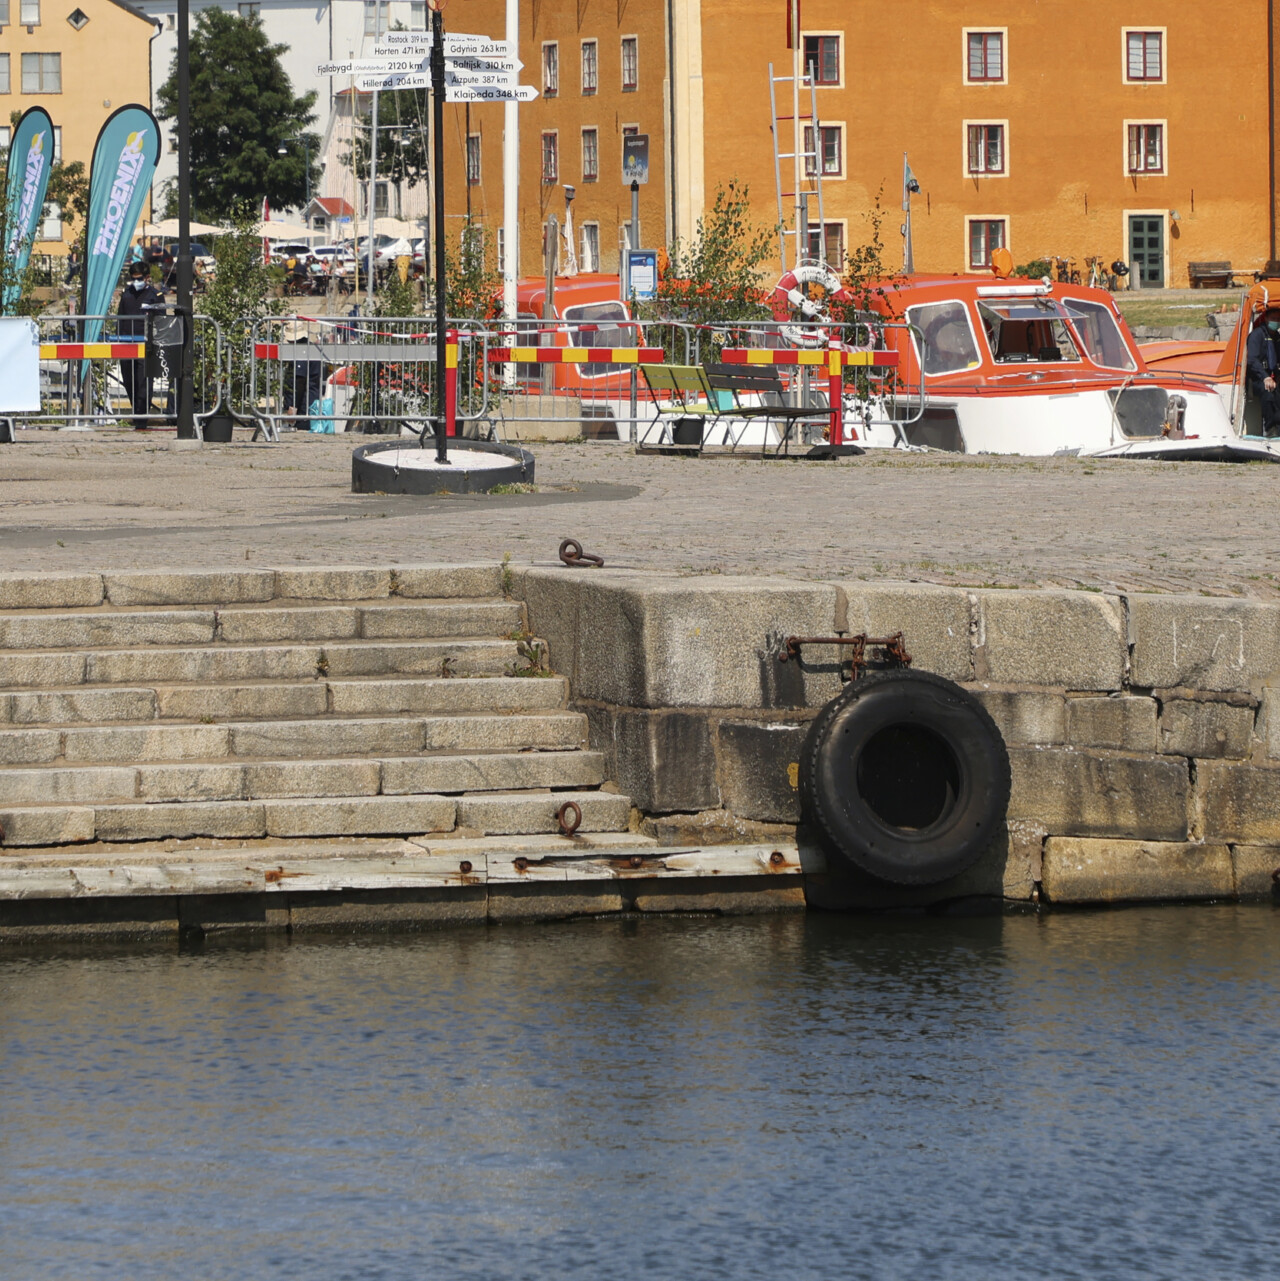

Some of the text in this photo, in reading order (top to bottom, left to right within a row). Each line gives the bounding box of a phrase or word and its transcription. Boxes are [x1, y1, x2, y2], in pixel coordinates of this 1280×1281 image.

[420, 35, 429, 43] km
[375, 46, 426, 55] Horten 471 km
[480, 45, 494, 53] 263
[388, 62, 407, 70] 2120
[409, 61, 423, 70] km
[453, 60, 514, 71] Baltijsk 310 km
[363, 77, 425, 88] Hillerød 204 km
[451, 76, 479, 85] Aizpute
[454, 90, 528, 100] Klaipeda 348 km
[93, 145, 142, 256] PHOENIX
